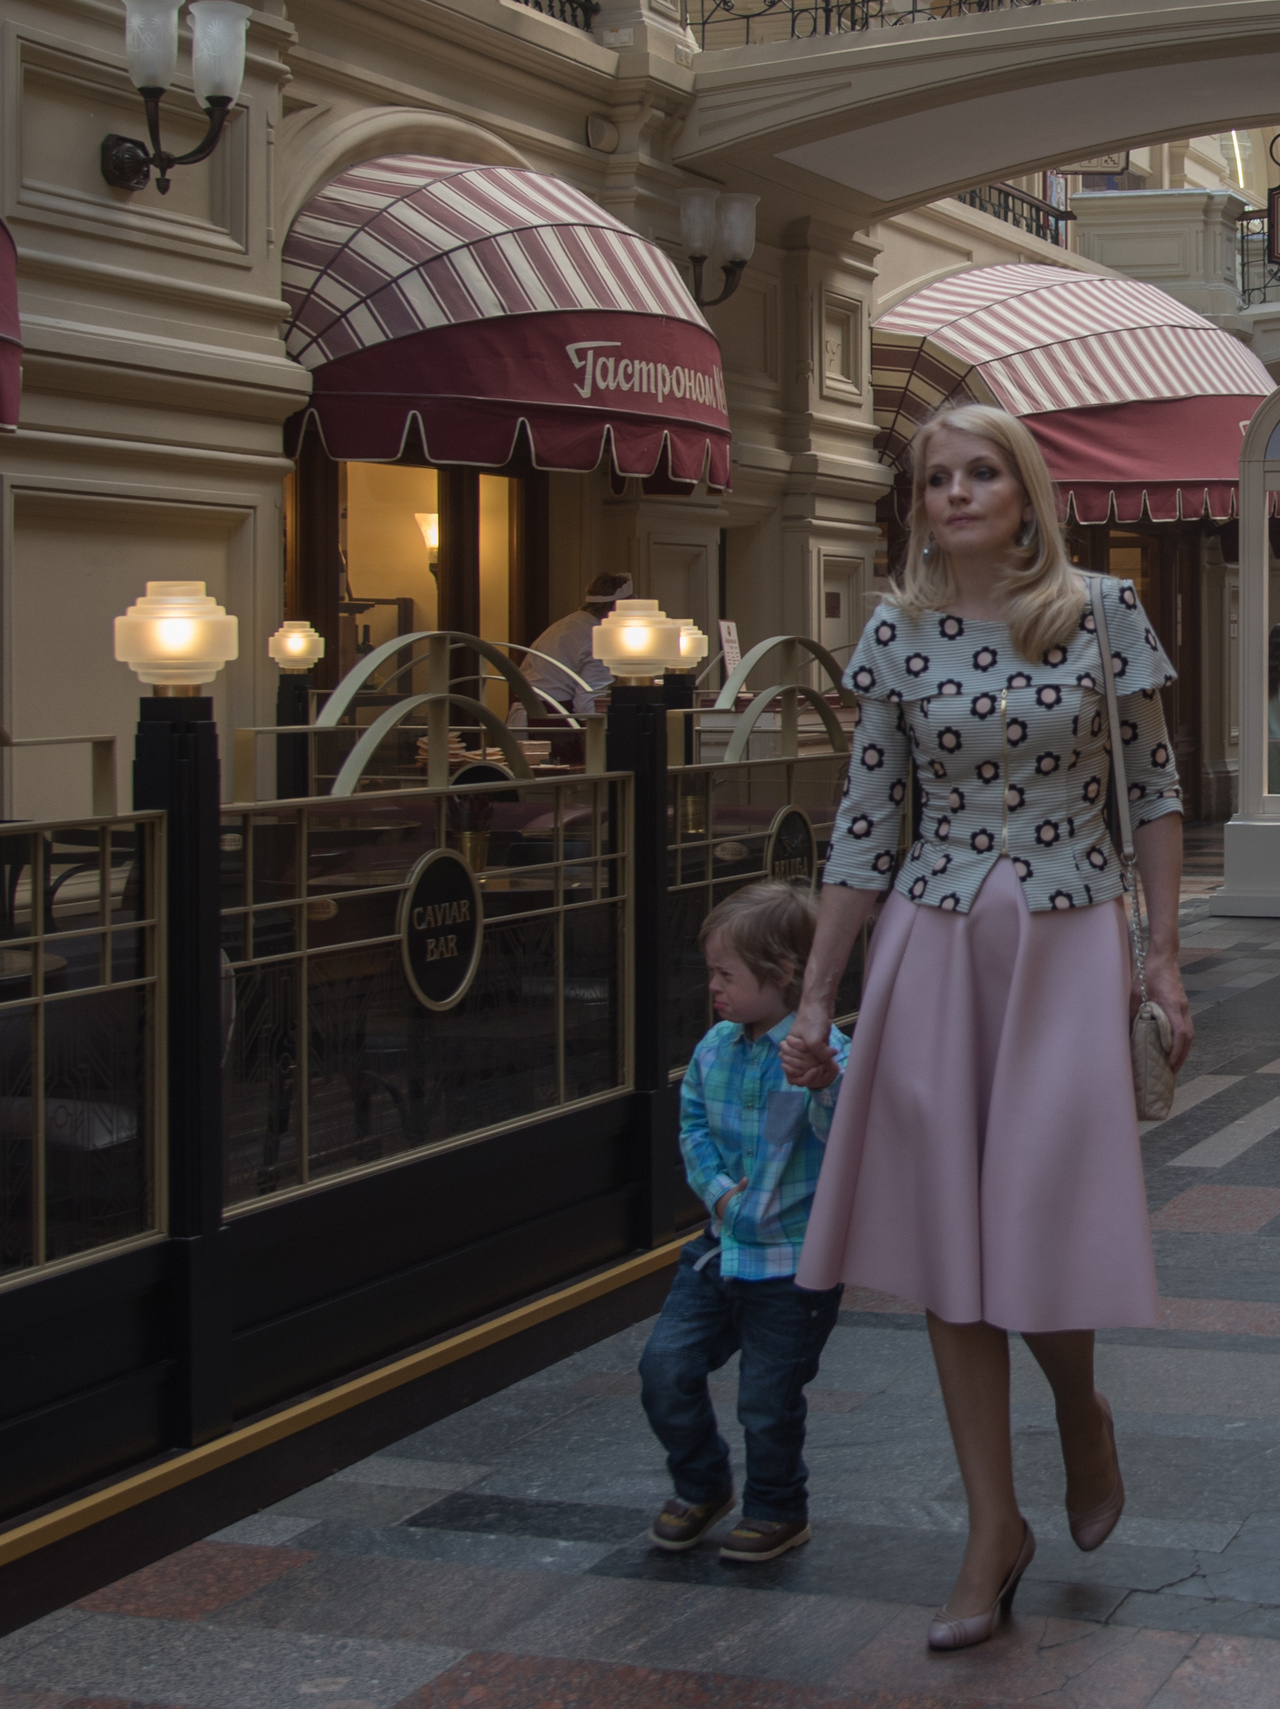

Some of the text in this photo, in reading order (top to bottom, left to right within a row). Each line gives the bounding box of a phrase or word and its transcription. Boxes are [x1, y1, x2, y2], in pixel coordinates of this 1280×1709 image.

[565, 341, 716, 409] Гастроном
[413, 899, 470, 930] CAVIAR
[426, 935, 458, 962] BAR
